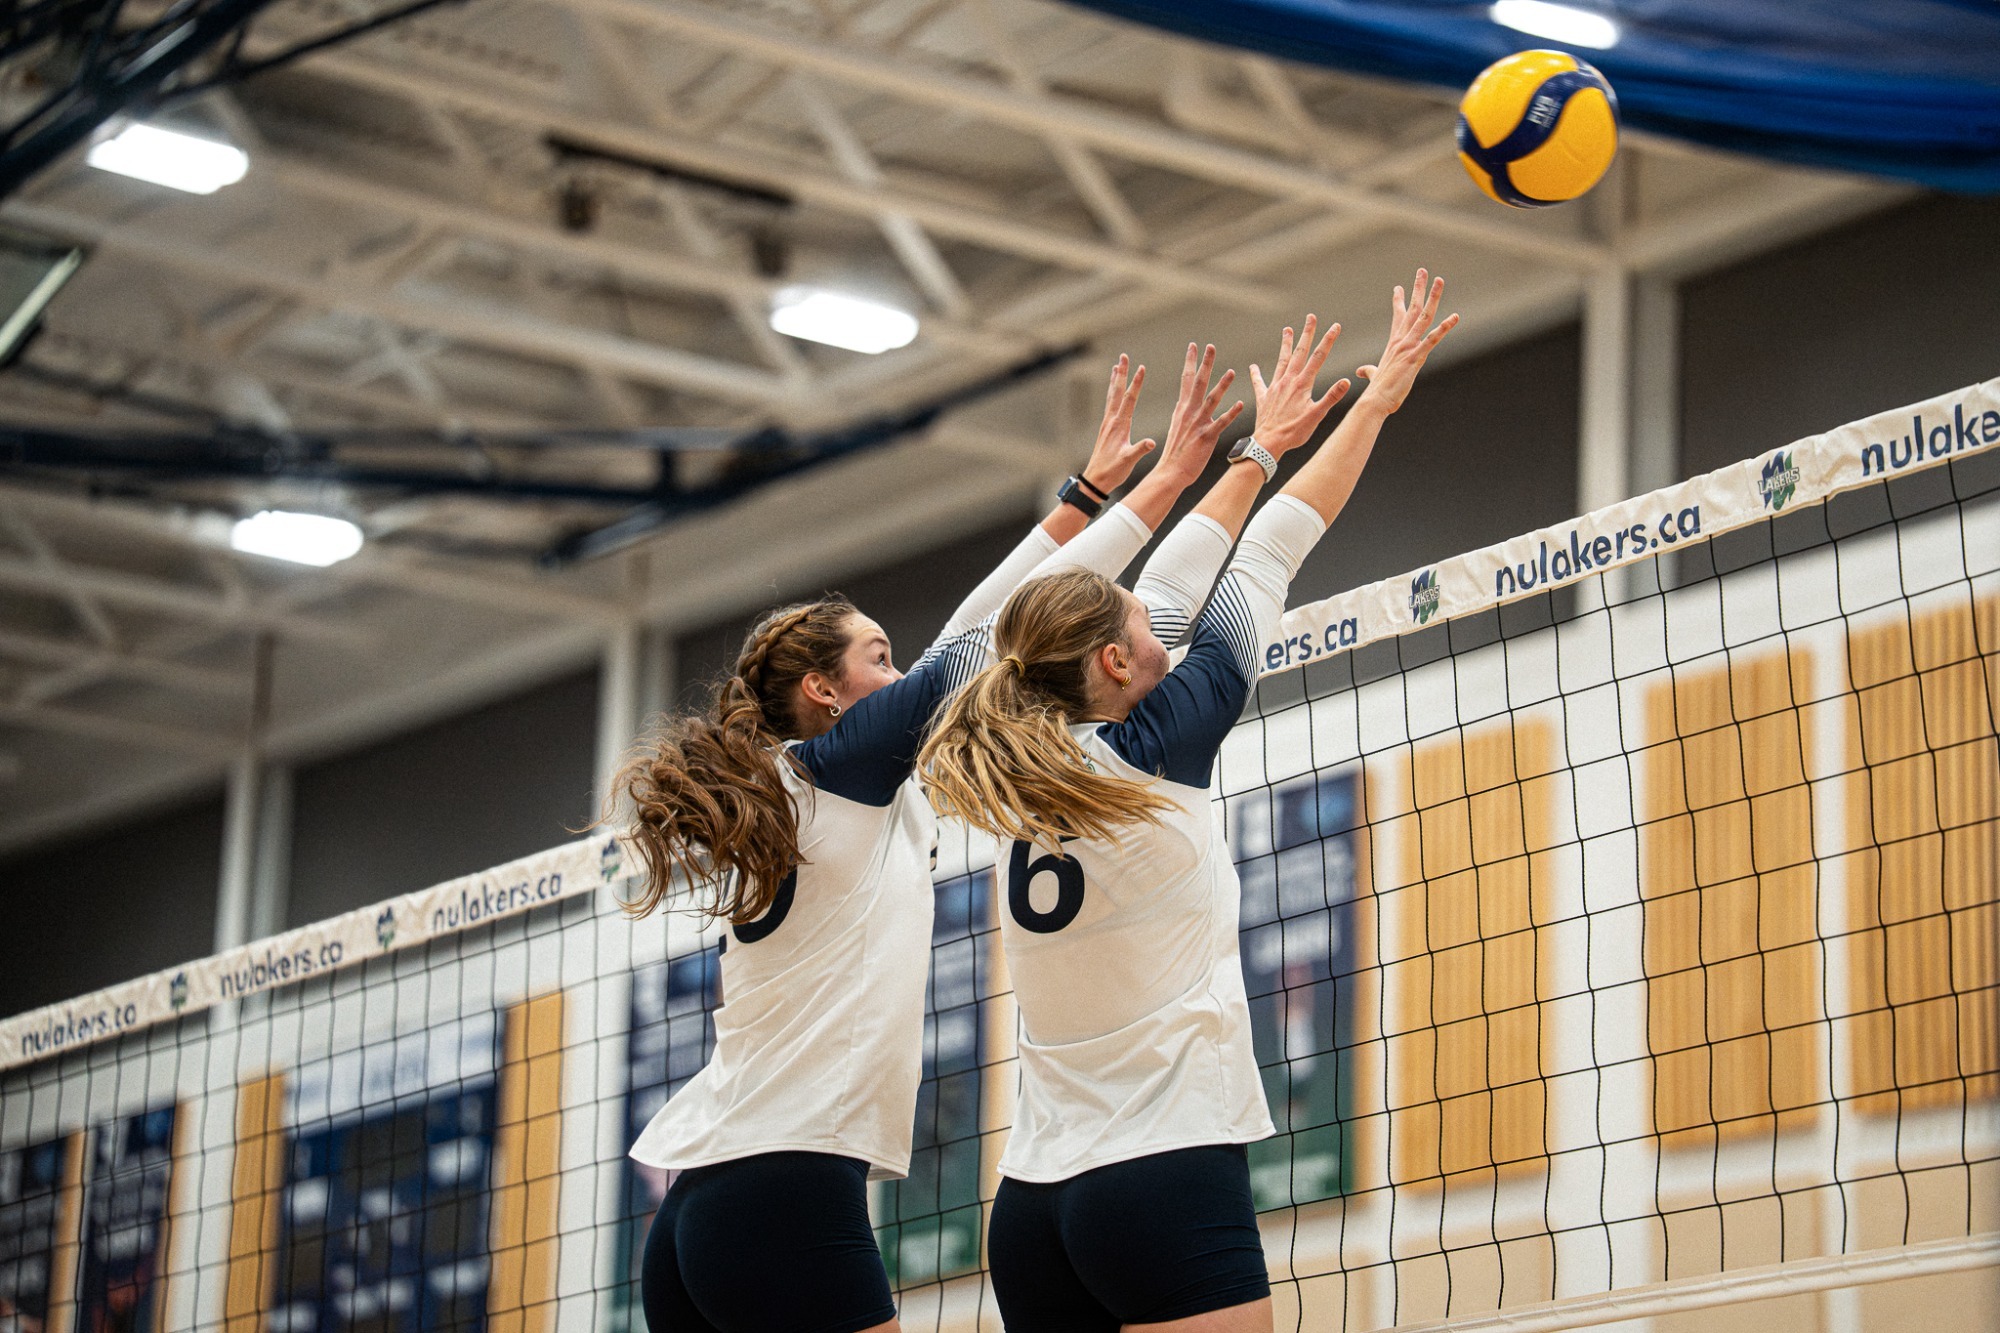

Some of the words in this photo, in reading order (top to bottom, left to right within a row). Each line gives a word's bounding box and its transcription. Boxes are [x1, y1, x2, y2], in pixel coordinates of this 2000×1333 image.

[1862, 403, 2000, 477] nulake
[1758, 467, 1800, 495] LAKERS
[1496, 505, 1701, 597] nulakers.ca
[1408, 584, 1440, 609] LAKERS
[1261, 617, 1357, 672] ers.ca
[433, 873, 562, 932] nulakers.ca
[1008, 815, 1085, 934] 6
